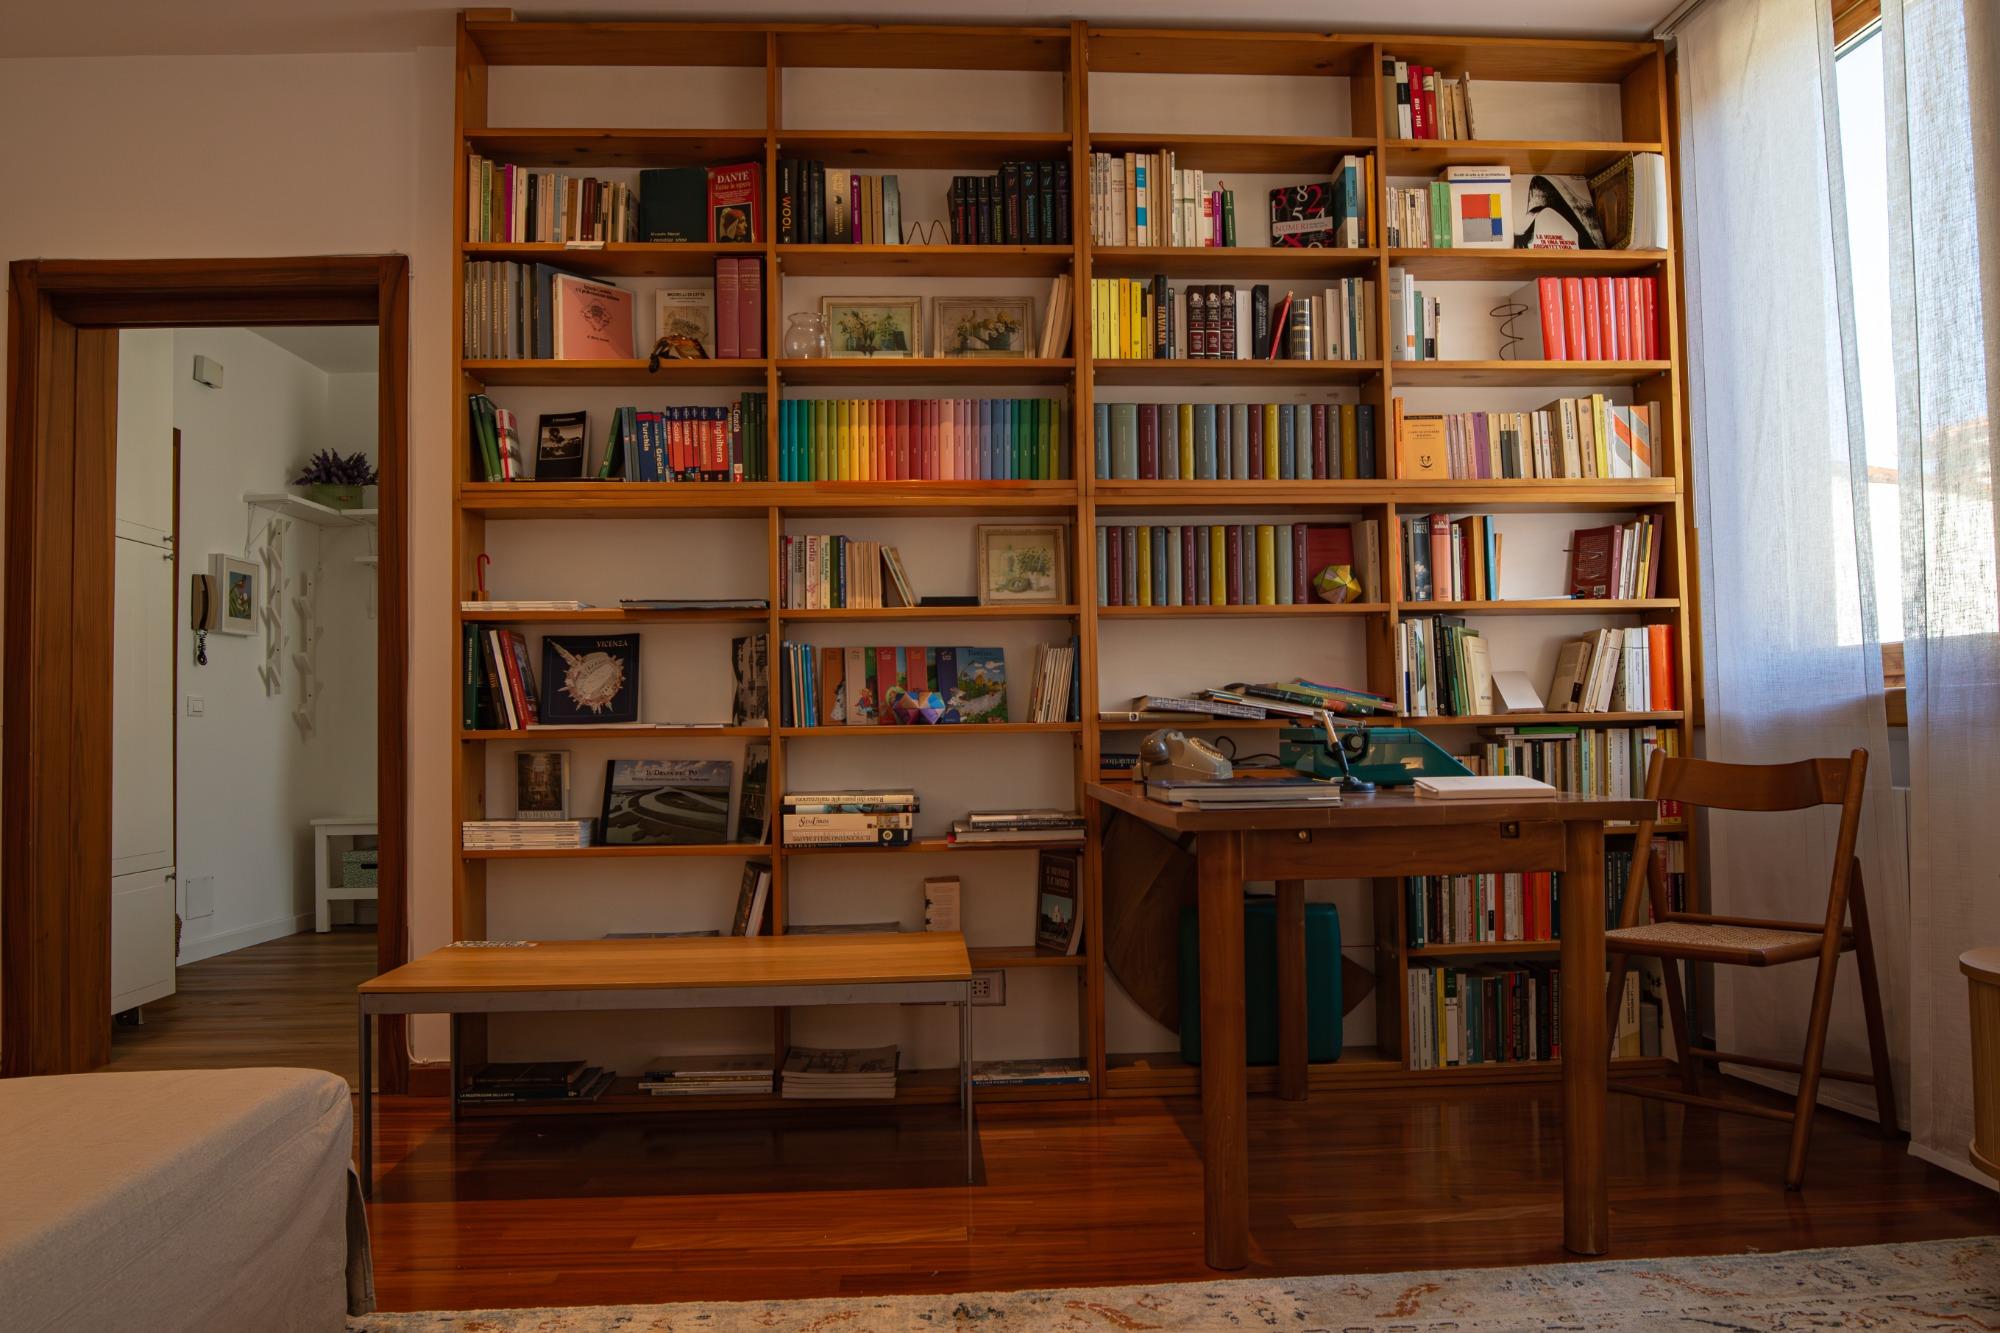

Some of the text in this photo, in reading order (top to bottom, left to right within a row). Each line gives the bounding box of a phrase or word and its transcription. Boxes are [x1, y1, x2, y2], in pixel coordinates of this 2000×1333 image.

[717, 171, 749, 183] DANTE
[782, 196, 791, 232] WOOL
[1275, 223, 1309, 234] NUMERI
[1157, 306, 1166, 345] HAVANA
[733, 409, 741, 432] Croazia
[642, 422, 650, 451] Turchia
[714, 421, 724, 463] Inghilterra
[808, 538, 817, 562] India
[596, 639, 628, 647] VICENZA
